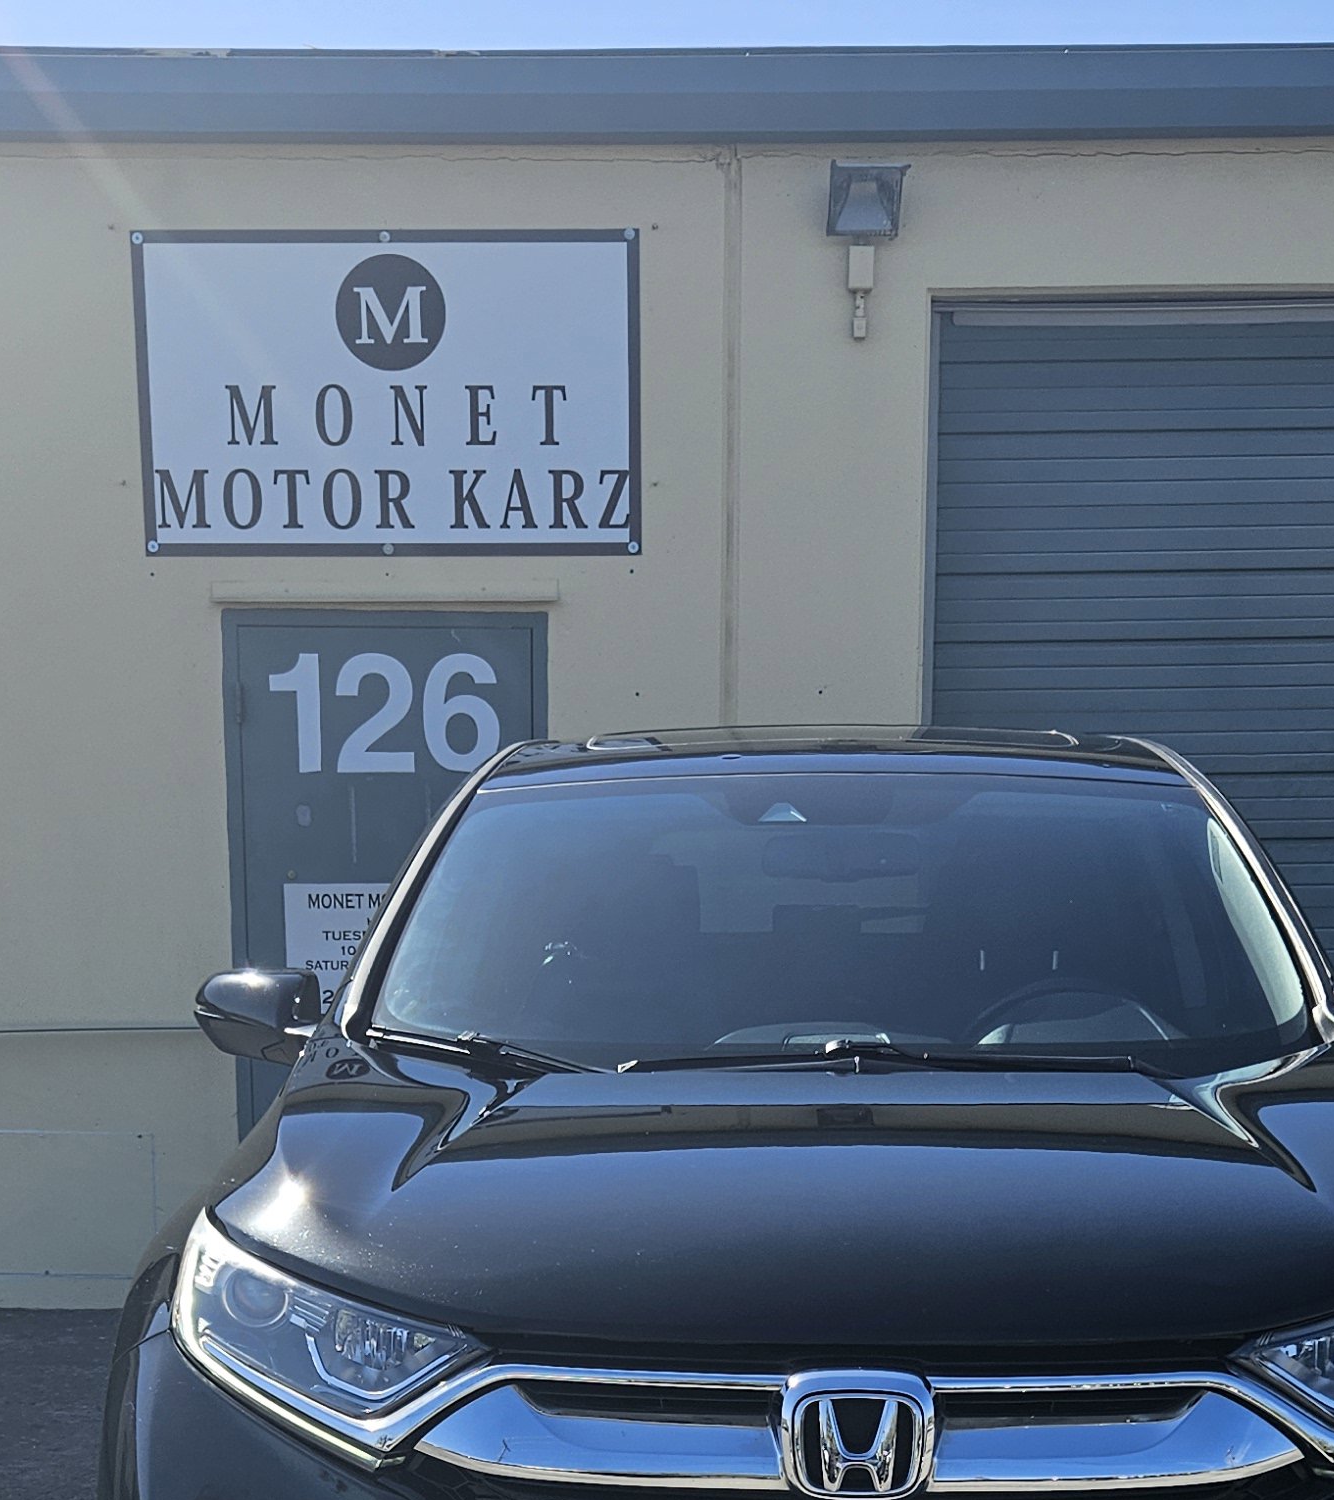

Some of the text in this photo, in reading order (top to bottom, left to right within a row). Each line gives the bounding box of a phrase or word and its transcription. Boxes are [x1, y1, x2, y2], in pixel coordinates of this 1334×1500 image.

[353, 286, 428, 344] M
[225, 384, 567, 447] MONET
[155, 468, 631, 529] MOTOR KARZ
[269, 652, 500, 773] 126
[308, 893, 387, 909] MONET M
[322, 930, 366, 941] TUES
[305, 960, 349, 971] SATUR
